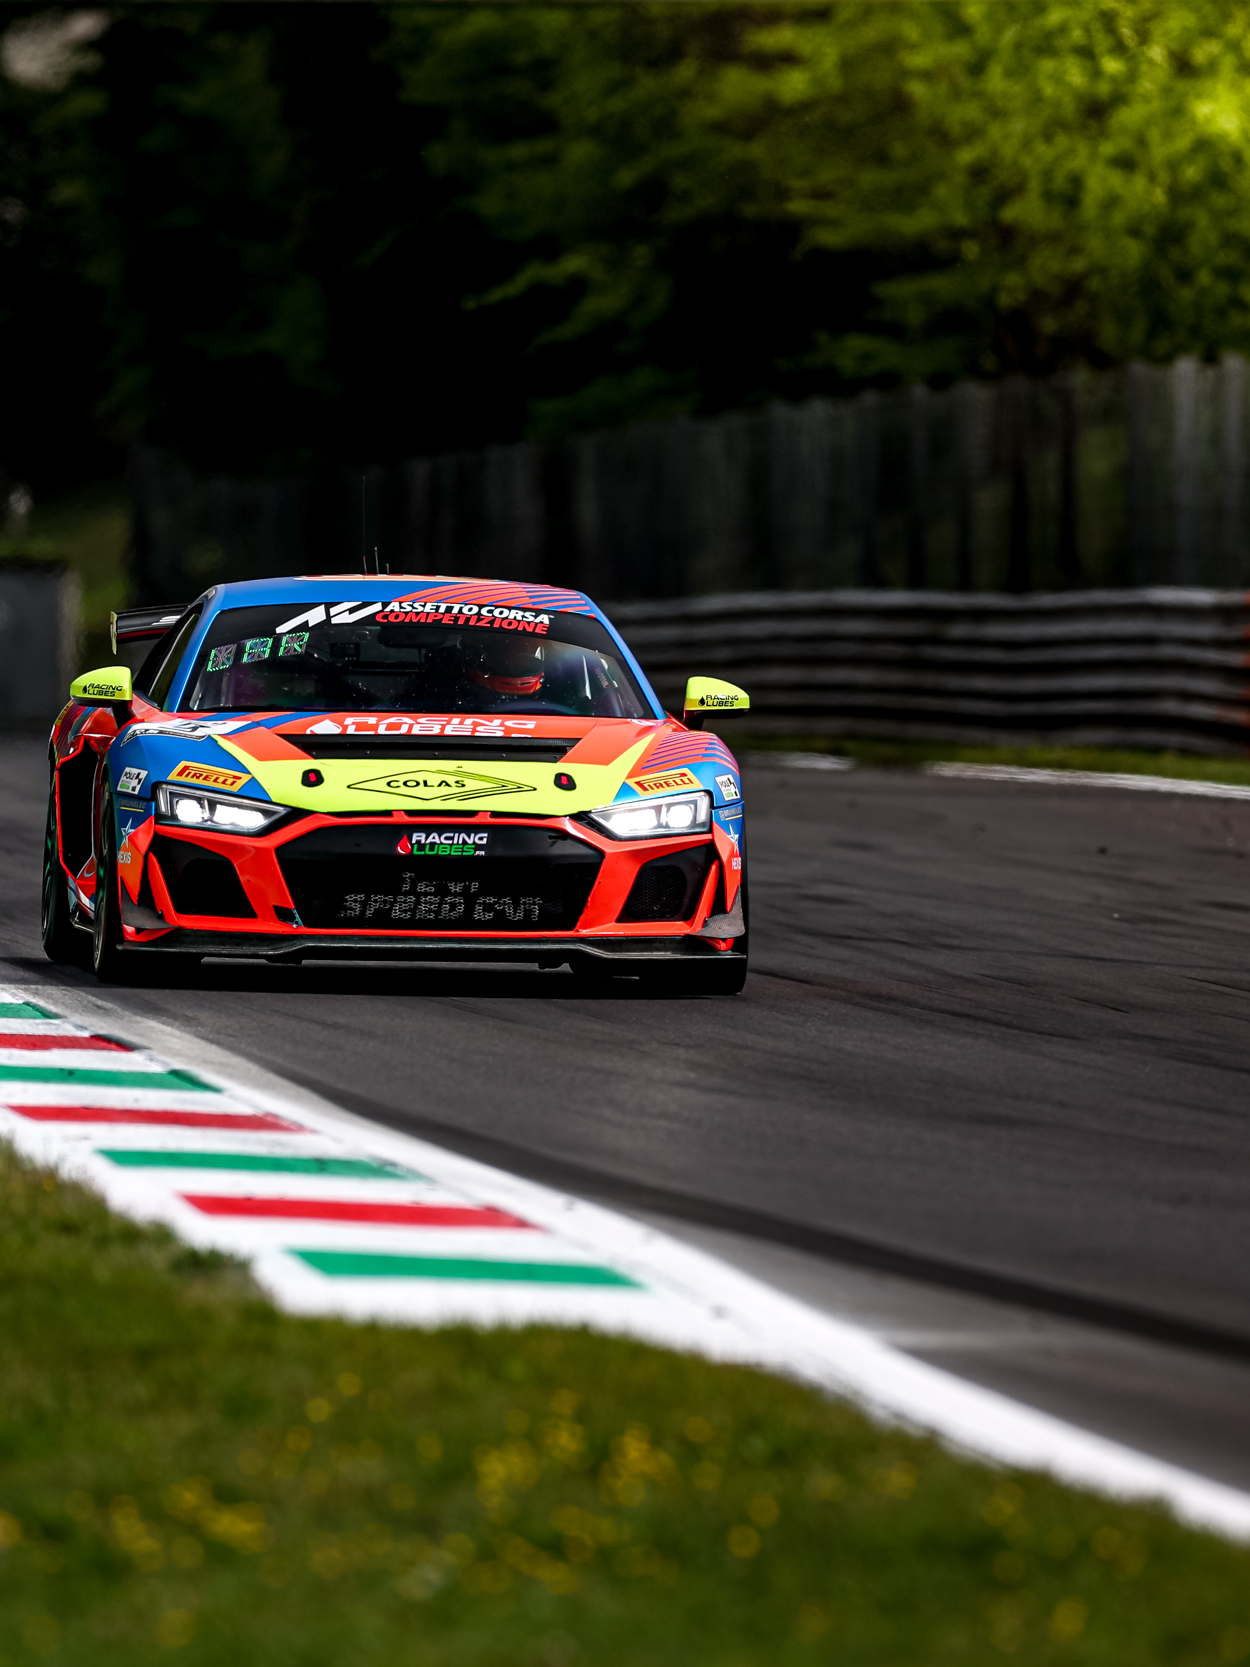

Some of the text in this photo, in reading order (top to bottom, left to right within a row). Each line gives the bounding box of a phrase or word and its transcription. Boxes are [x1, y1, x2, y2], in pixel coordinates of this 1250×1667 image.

[384, 602, 551, 625] ASSETTO CORSA
[375, 612, 550, 635] COMPETIZIONE
[87, 683, 123, 692] RACING
[87, 689, 116, 697] LUBES
[343, 717, 537, 729] RACING
[352, 724, 505, 737] LUBES
[176, 765, 242, 787] PIRELLI
[634, 772, 695, 792] PIRELLI
[386, 779, 467, 789] COLAS
[411, 832, 488, 845] RACING
[338, 894, 465, 920] SPEED
